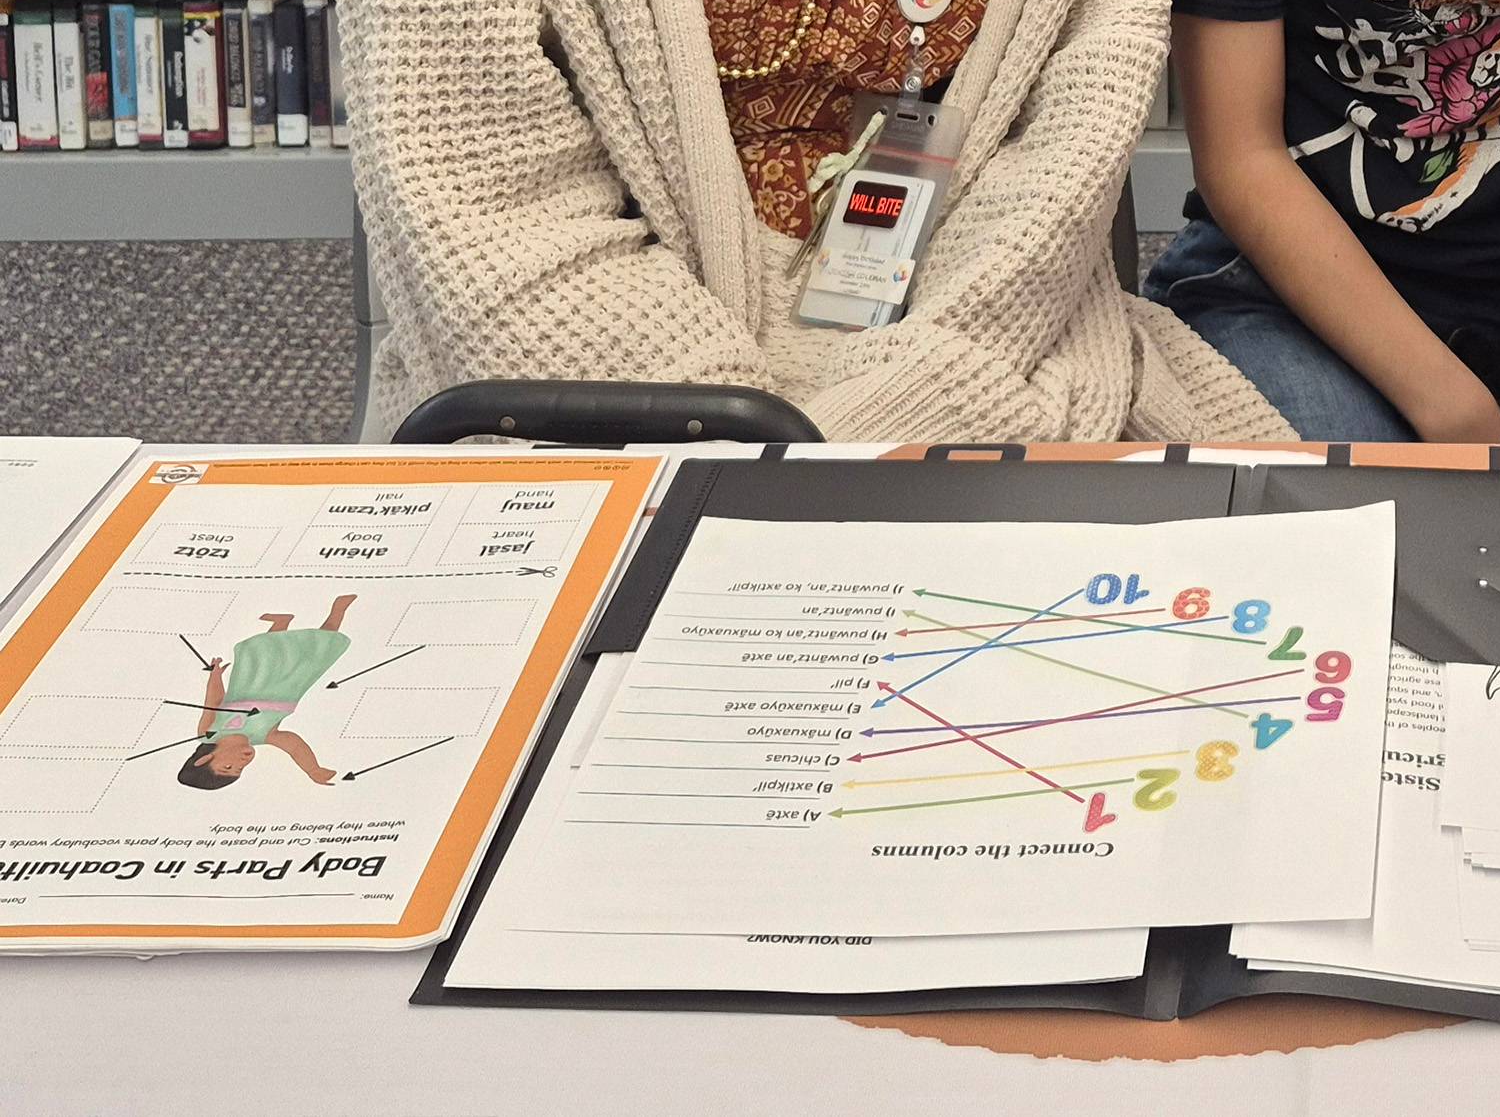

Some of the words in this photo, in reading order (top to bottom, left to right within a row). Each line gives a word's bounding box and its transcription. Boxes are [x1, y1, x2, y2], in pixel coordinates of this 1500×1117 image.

[64, 56, 74, 73] The
[849, 193, 876, 213] WILL
[876, 196, 904, 217] BITE
[375, 492, 405, 503] nail
[514, 489, 555, 500] hand
[499, 500, 556, 513] mauj
[188, 533, 235, 545] chest
[341, 531, 383, 544] body
[491, 529, 535, 541] heart
[785, 583, 802, 593] ko
[1084, 573, 1150, 607] 10
[1171, 587, 1211, 619] 9
[886, 605, 896, 617] I)
[1232, 601, 1271, 633] 8
[764, 629, 783, 639] ko
[871, 629, 888, 641] H)
[1267, 627, 1307, 661] 7
[862, 653, 880, 665] G)
[1314, 651, 1353, 684] 6
[856, 677, 870, 689] F)
[846, 703, 862, 714] E)
[1304, 687, 1346, 722] 5
[834, 727, 853, 739] D)
[1250, 713, 1294, 750] 4
[765, 754, 822, 765] chicuas
[824, 754, 840, 766] C)
[1195, 741, 1239, 783] 3
[816, 781, 834, 793] B)
[1132, 769, 1181, 811] 2
[803, 809, 822, 821] A)
[1082, 792, 1116, 833] 1
[208, 823, 244, 835] body.
[246, 825, 266, 835] the
[270, 824, 286, 832] on
[289, 821, 334, 834] belong
[336, 819, 363, 831] they
[367, 819, 406, 829] where
[9, 839, 48, 849] words
[50, 837, 121, 849] vocabulary
[124, 836, 159, 847] parts
[160, 835, 192, 849] body
[196, 839, 217, 849] the
[220, 835, 257, 847] paste
[259, 837, 284, 847] and
[287, 837, 311, 846] Cut
[316, 833, 400, 845] Instructions:
[870, 843, 969, 862] columns
[974, 843, 1012, 860] the
[1018, 841, 1115, 859] Connect
[154, 861, 186, 879] in
[194, 859, 293, 880] Parts
[299, 851, 387, 878] Body
[360, 893, 394, 901] Name:
[746, 935, 805, 944] KNOW?
[808, 935, 840, 945] YOU
[844, 936, 872, 945] DID
